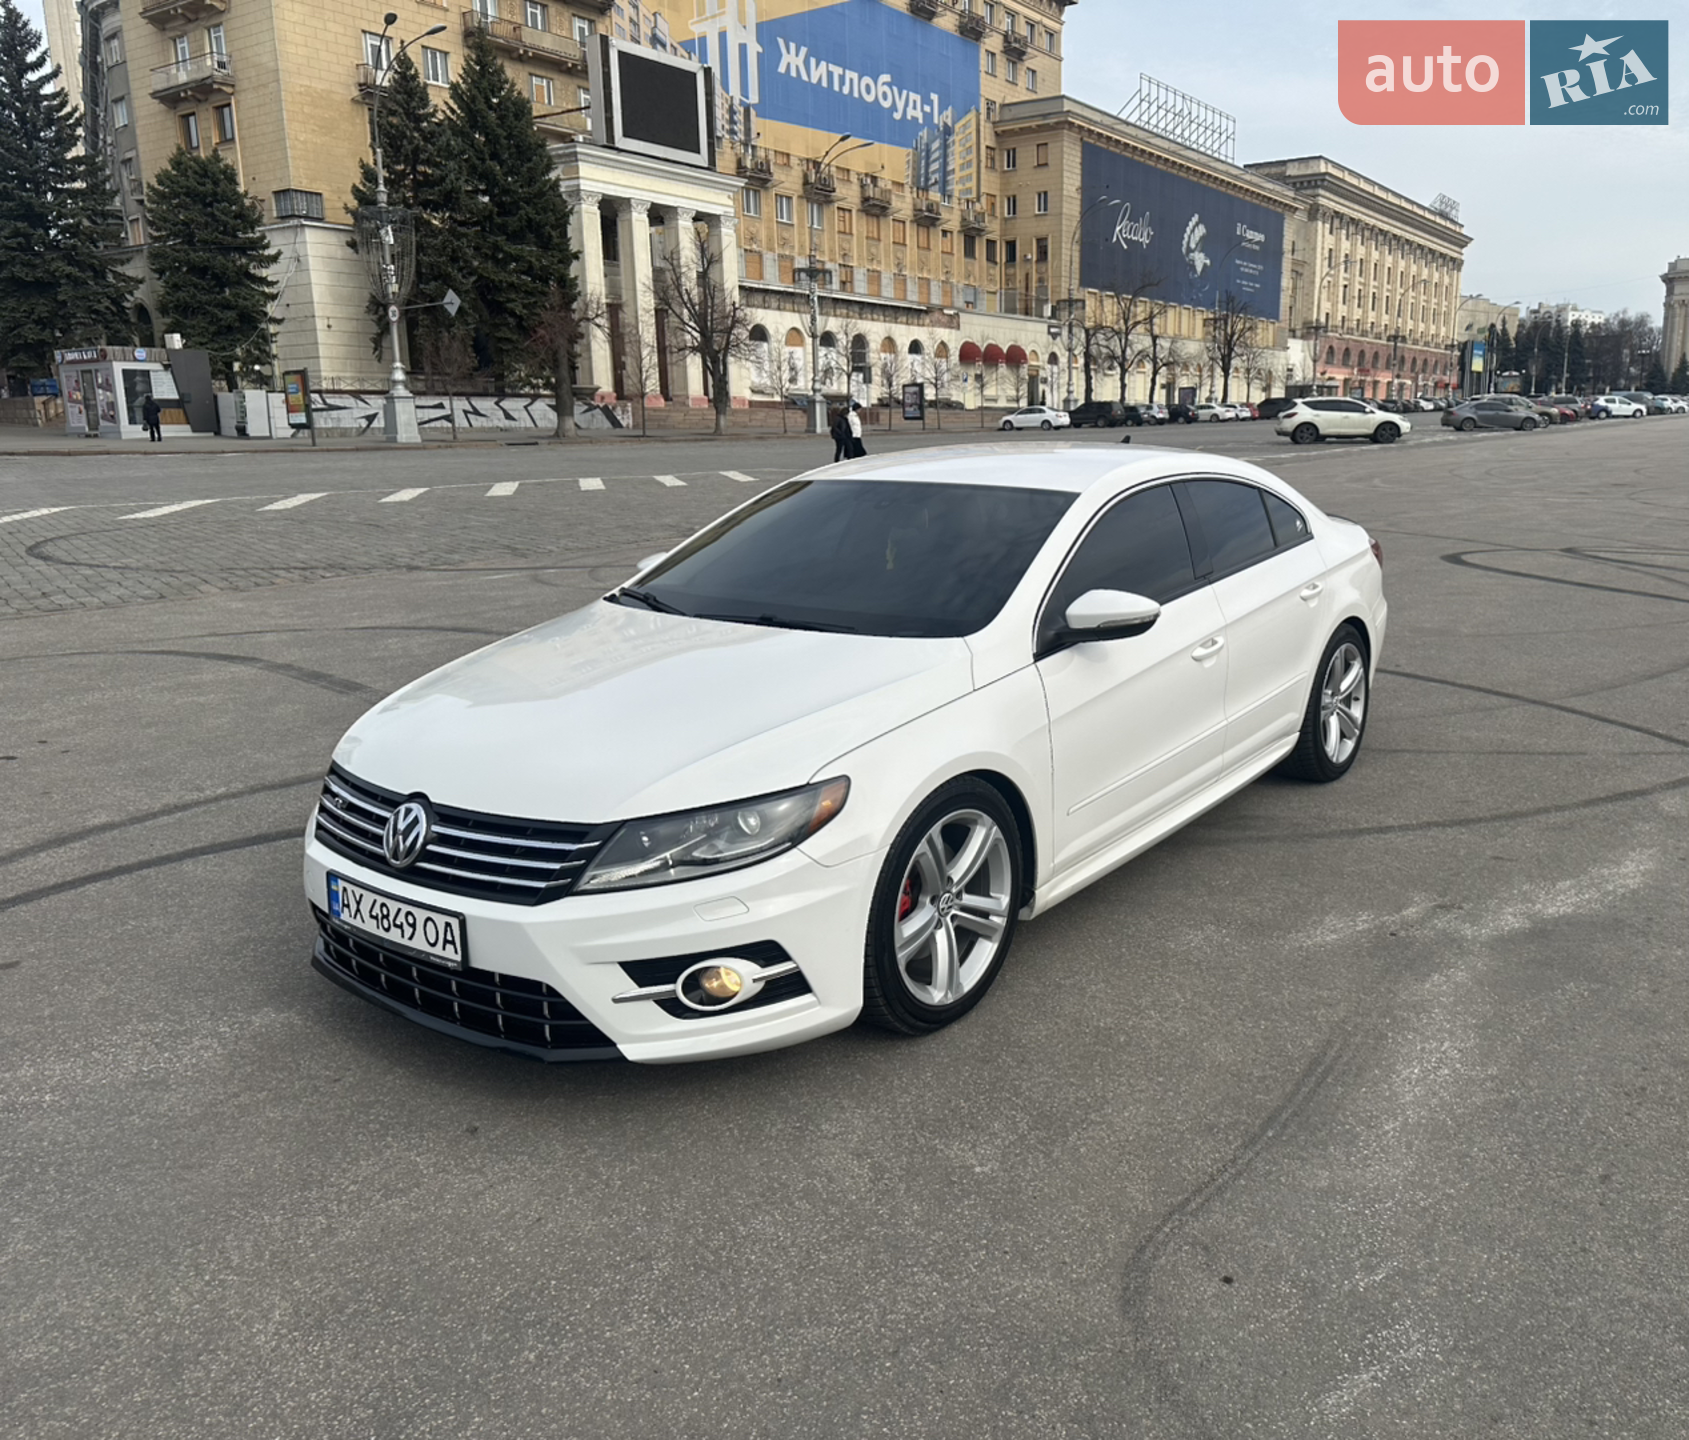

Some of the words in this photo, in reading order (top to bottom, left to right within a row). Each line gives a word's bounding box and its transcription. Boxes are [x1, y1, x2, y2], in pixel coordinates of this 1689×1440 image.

[777, 37, 940, 125] Житлобуд-1
[341, 886, 365, 923] AX
[369, 898, 417, 941] 4849
[423, 916, 458, 955] OA
